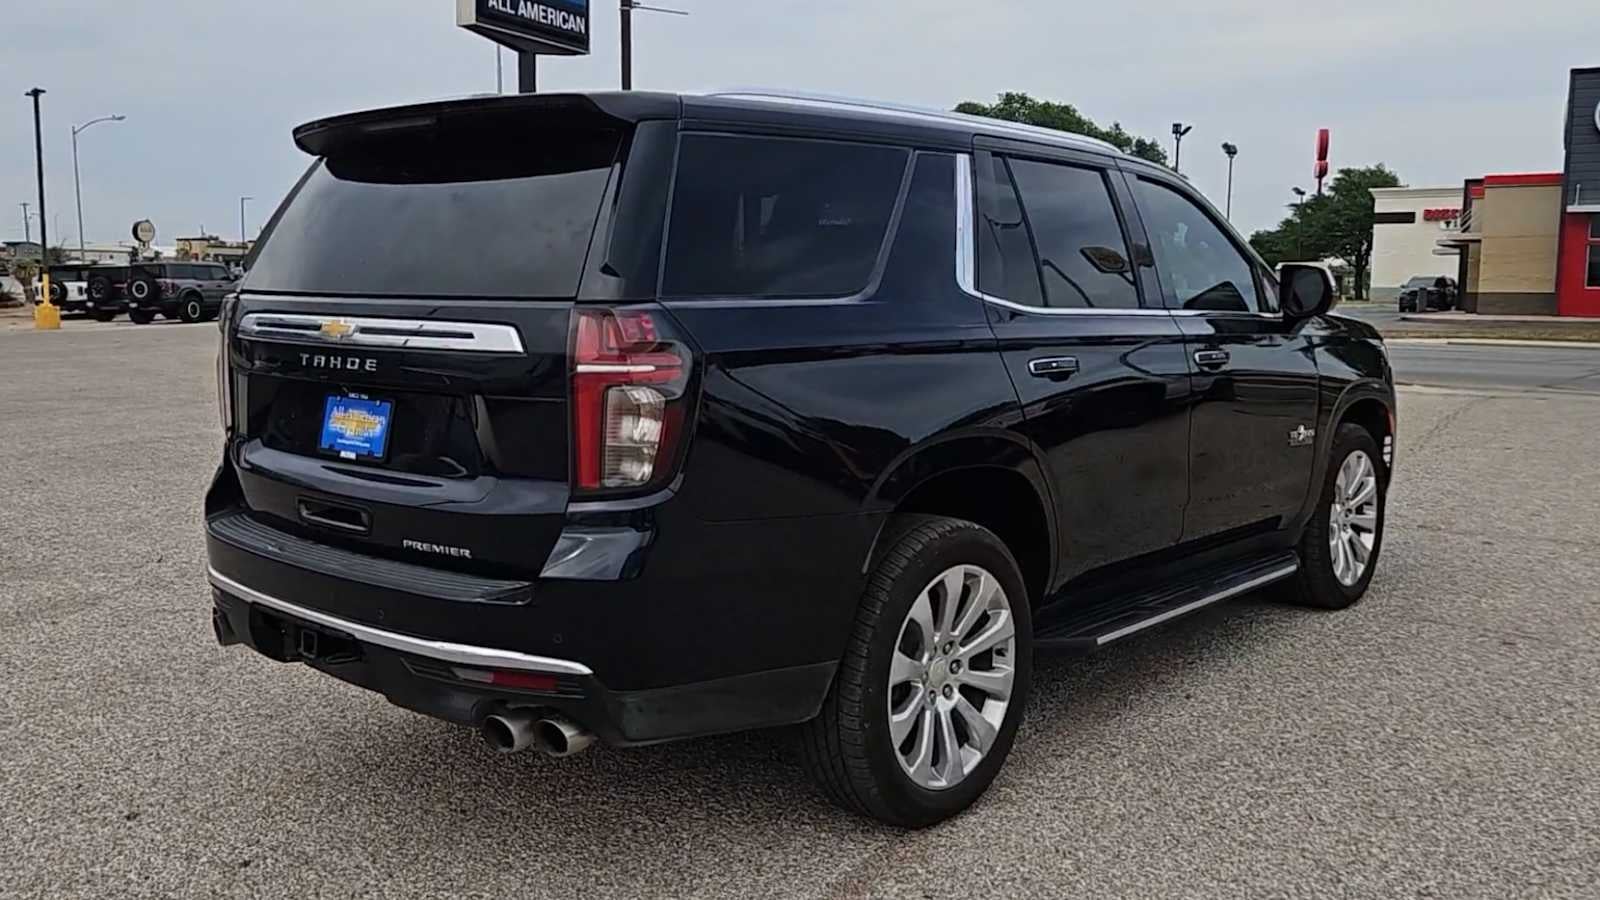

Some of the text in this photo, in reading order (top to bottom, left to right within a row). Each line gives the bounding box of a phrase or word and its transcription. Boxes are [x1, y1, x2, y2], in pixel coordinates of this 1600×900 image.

[488, 0, 586, 34] ALL AMERICAN
[299, 353, 377, 372] TAHOE
[402, 539, 473, 559] PREMIER
